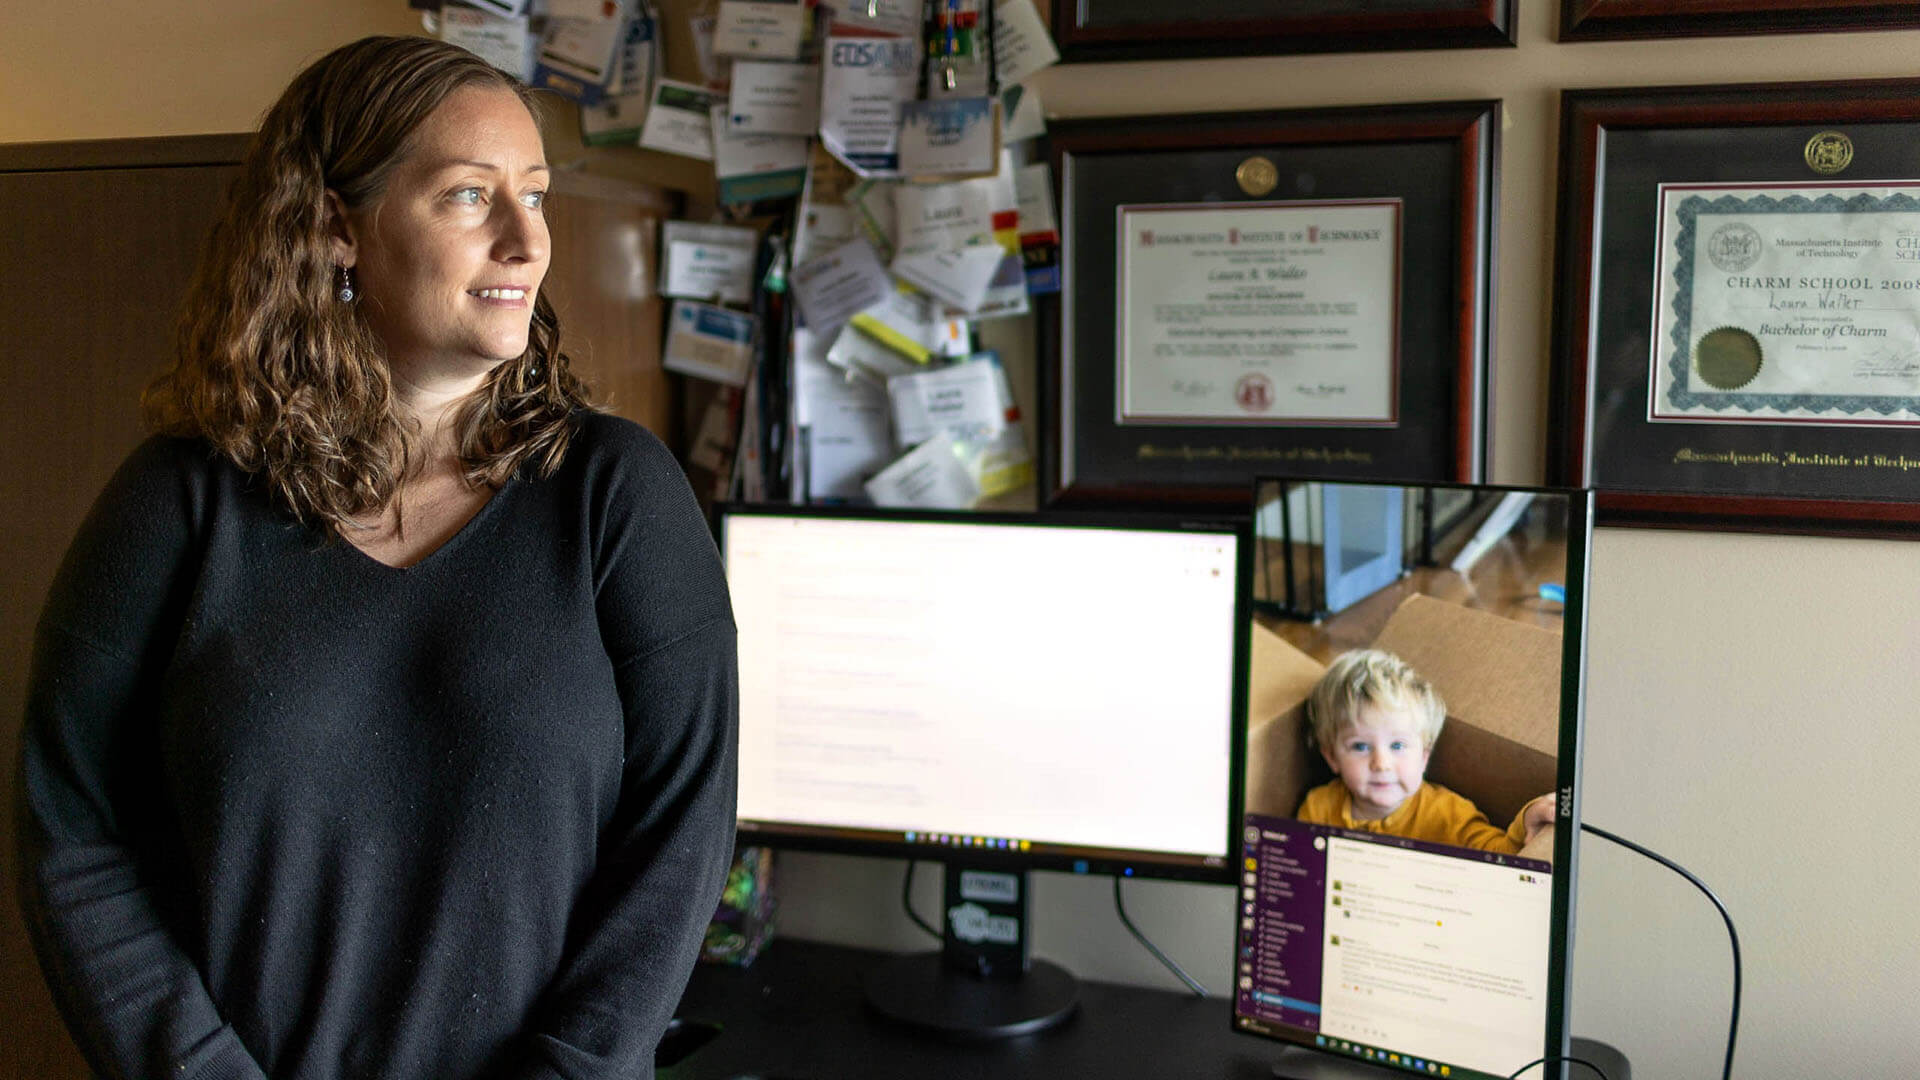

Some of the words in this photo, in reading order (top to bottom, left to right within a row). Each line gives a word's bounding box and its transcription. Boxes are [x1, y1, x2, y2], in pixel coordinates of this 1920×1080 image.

[1776, 238, 1841, 248] Massachusetts
[1844, 238, 1882, 248] Institute
[1796, 250, 1807, 258] of
[1808, 249, 1859, 259] Technology
[1727, 277, 1791, 289] CHARM
[1800, 277, 1873, 290] SCHOOL
[1769, 290, 1808, 311] Laura
[1760, 324, 1819, 337] Bachelor
[1823, 324, 1838, 343] of
[1840, 325, 1887, 338] Charm
[1561, 786, 1572, 817] DELL
